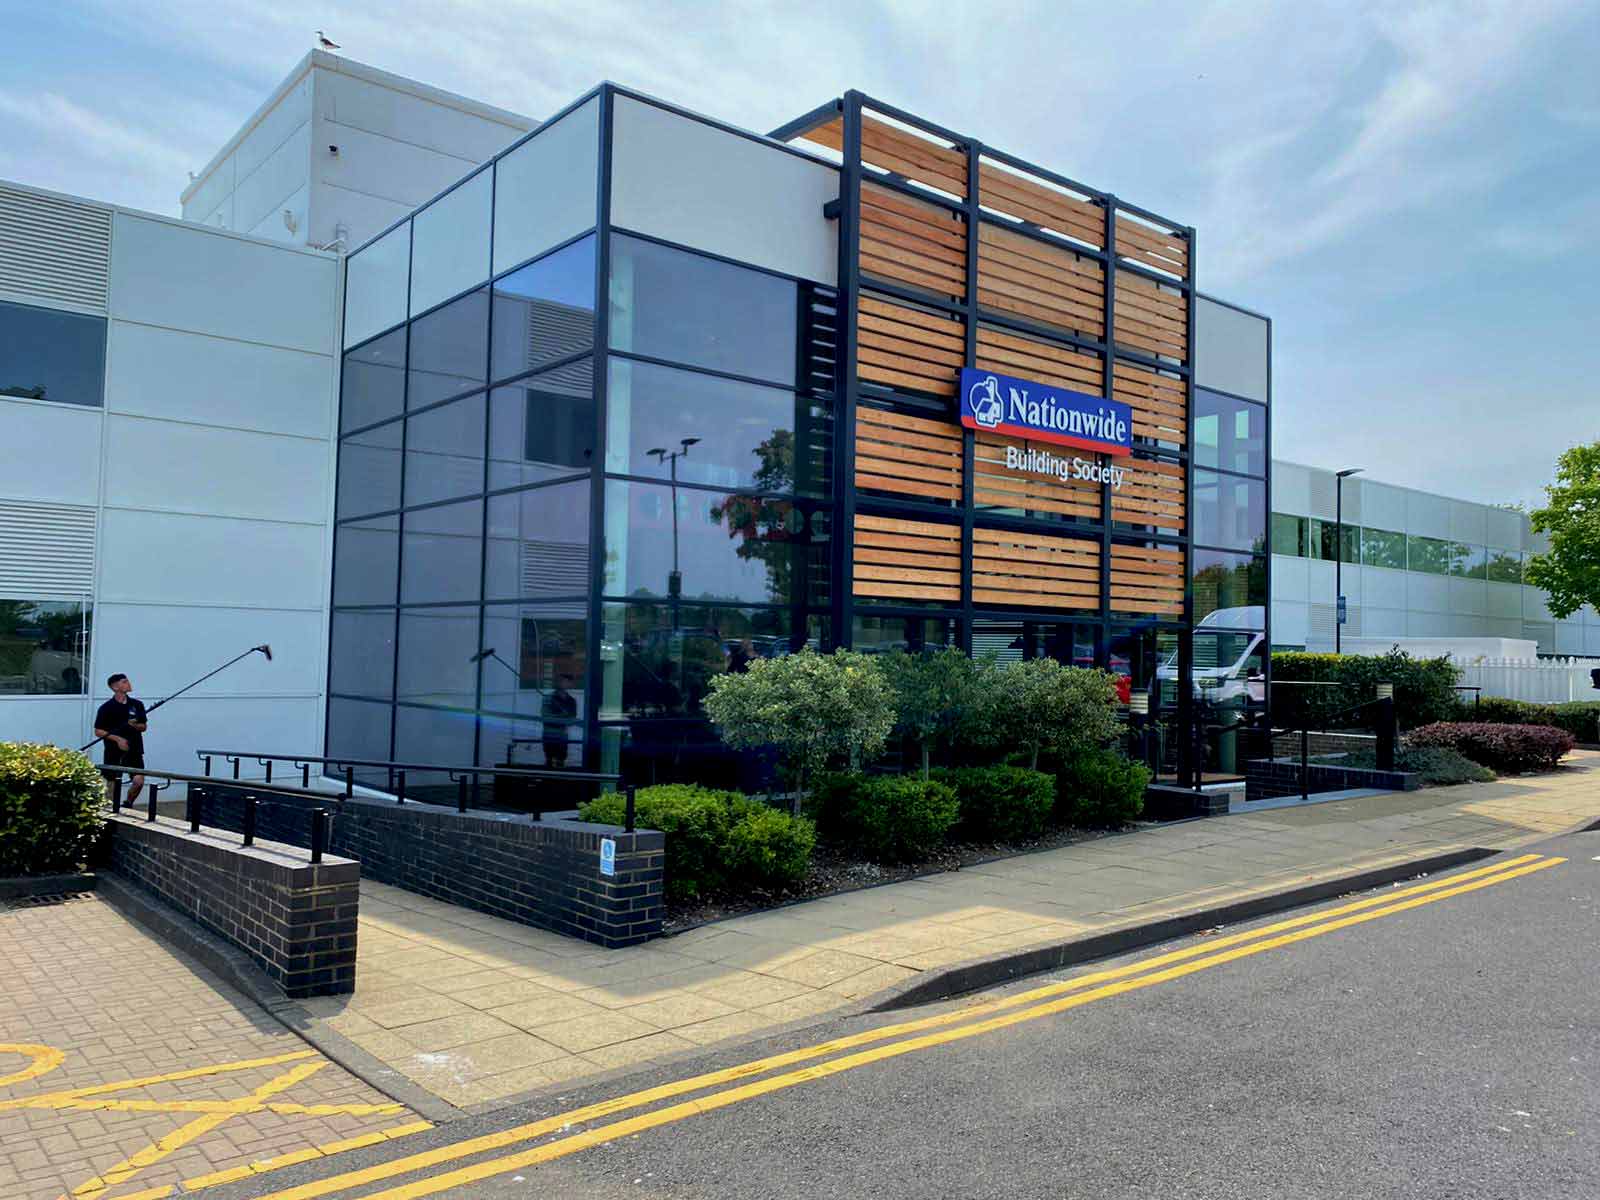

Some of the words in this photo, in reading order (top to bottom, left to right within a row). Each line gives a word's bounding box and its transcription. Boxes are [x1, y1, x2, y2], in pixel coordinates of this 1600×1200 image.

[1008, 387, 1127, 442] Nationwide
[1006, 446, 1069, 482] Building
[1072, 458, 1124, 489] Society
